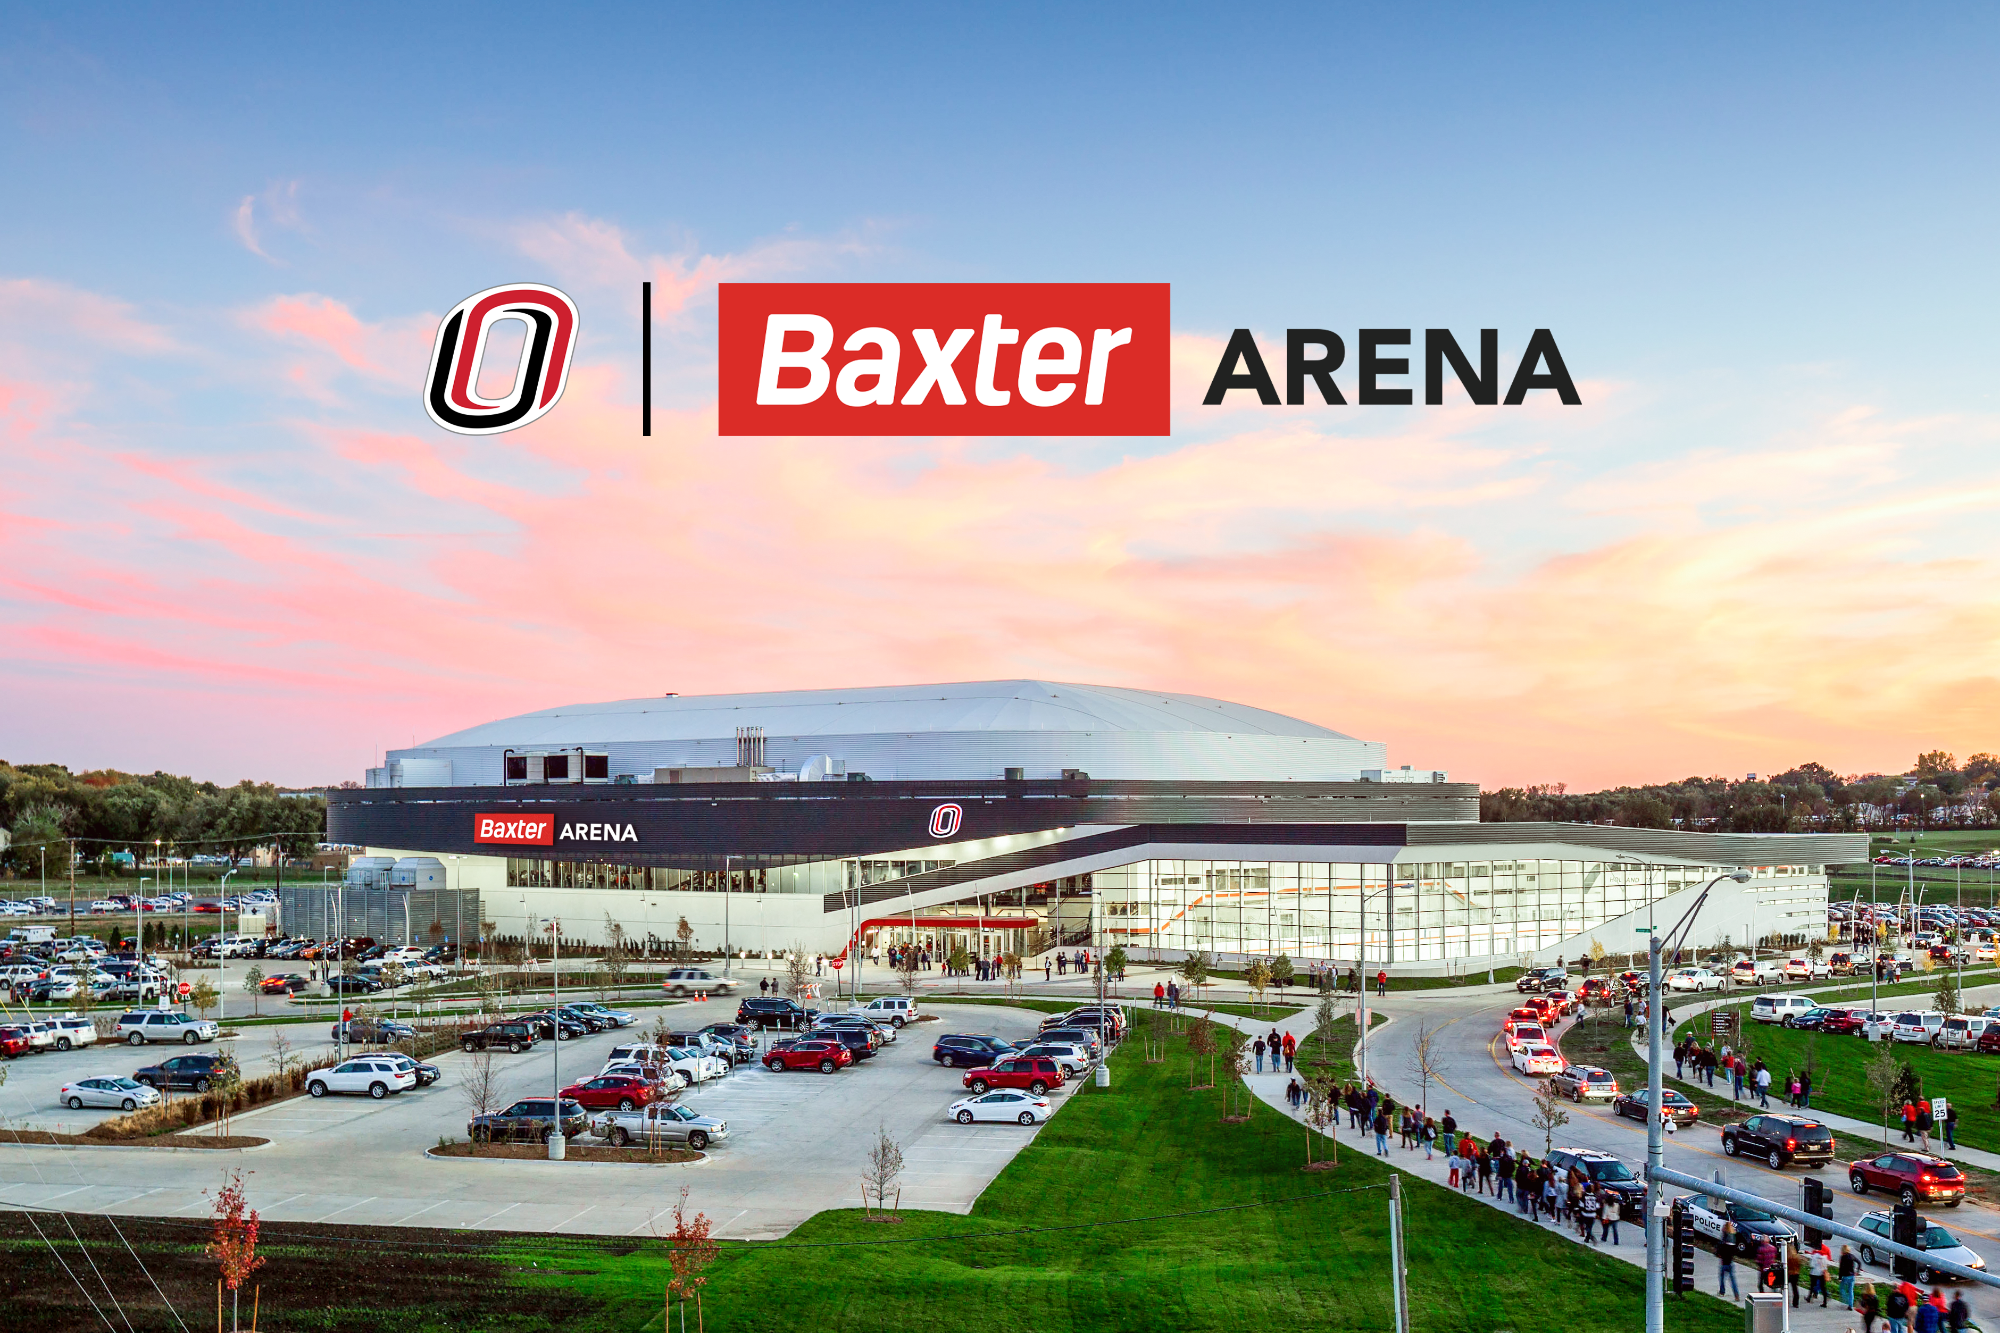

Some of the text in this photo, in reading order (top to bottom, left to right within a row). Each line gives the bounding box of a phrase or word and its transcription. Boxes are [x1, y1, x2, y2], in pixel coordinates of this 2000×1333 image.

[480, 819, 638, 842] Baxter ARENA
[1934, 1109, 1945, 1118] 25
[1694, 1215, 1721, 1232] POLICE
